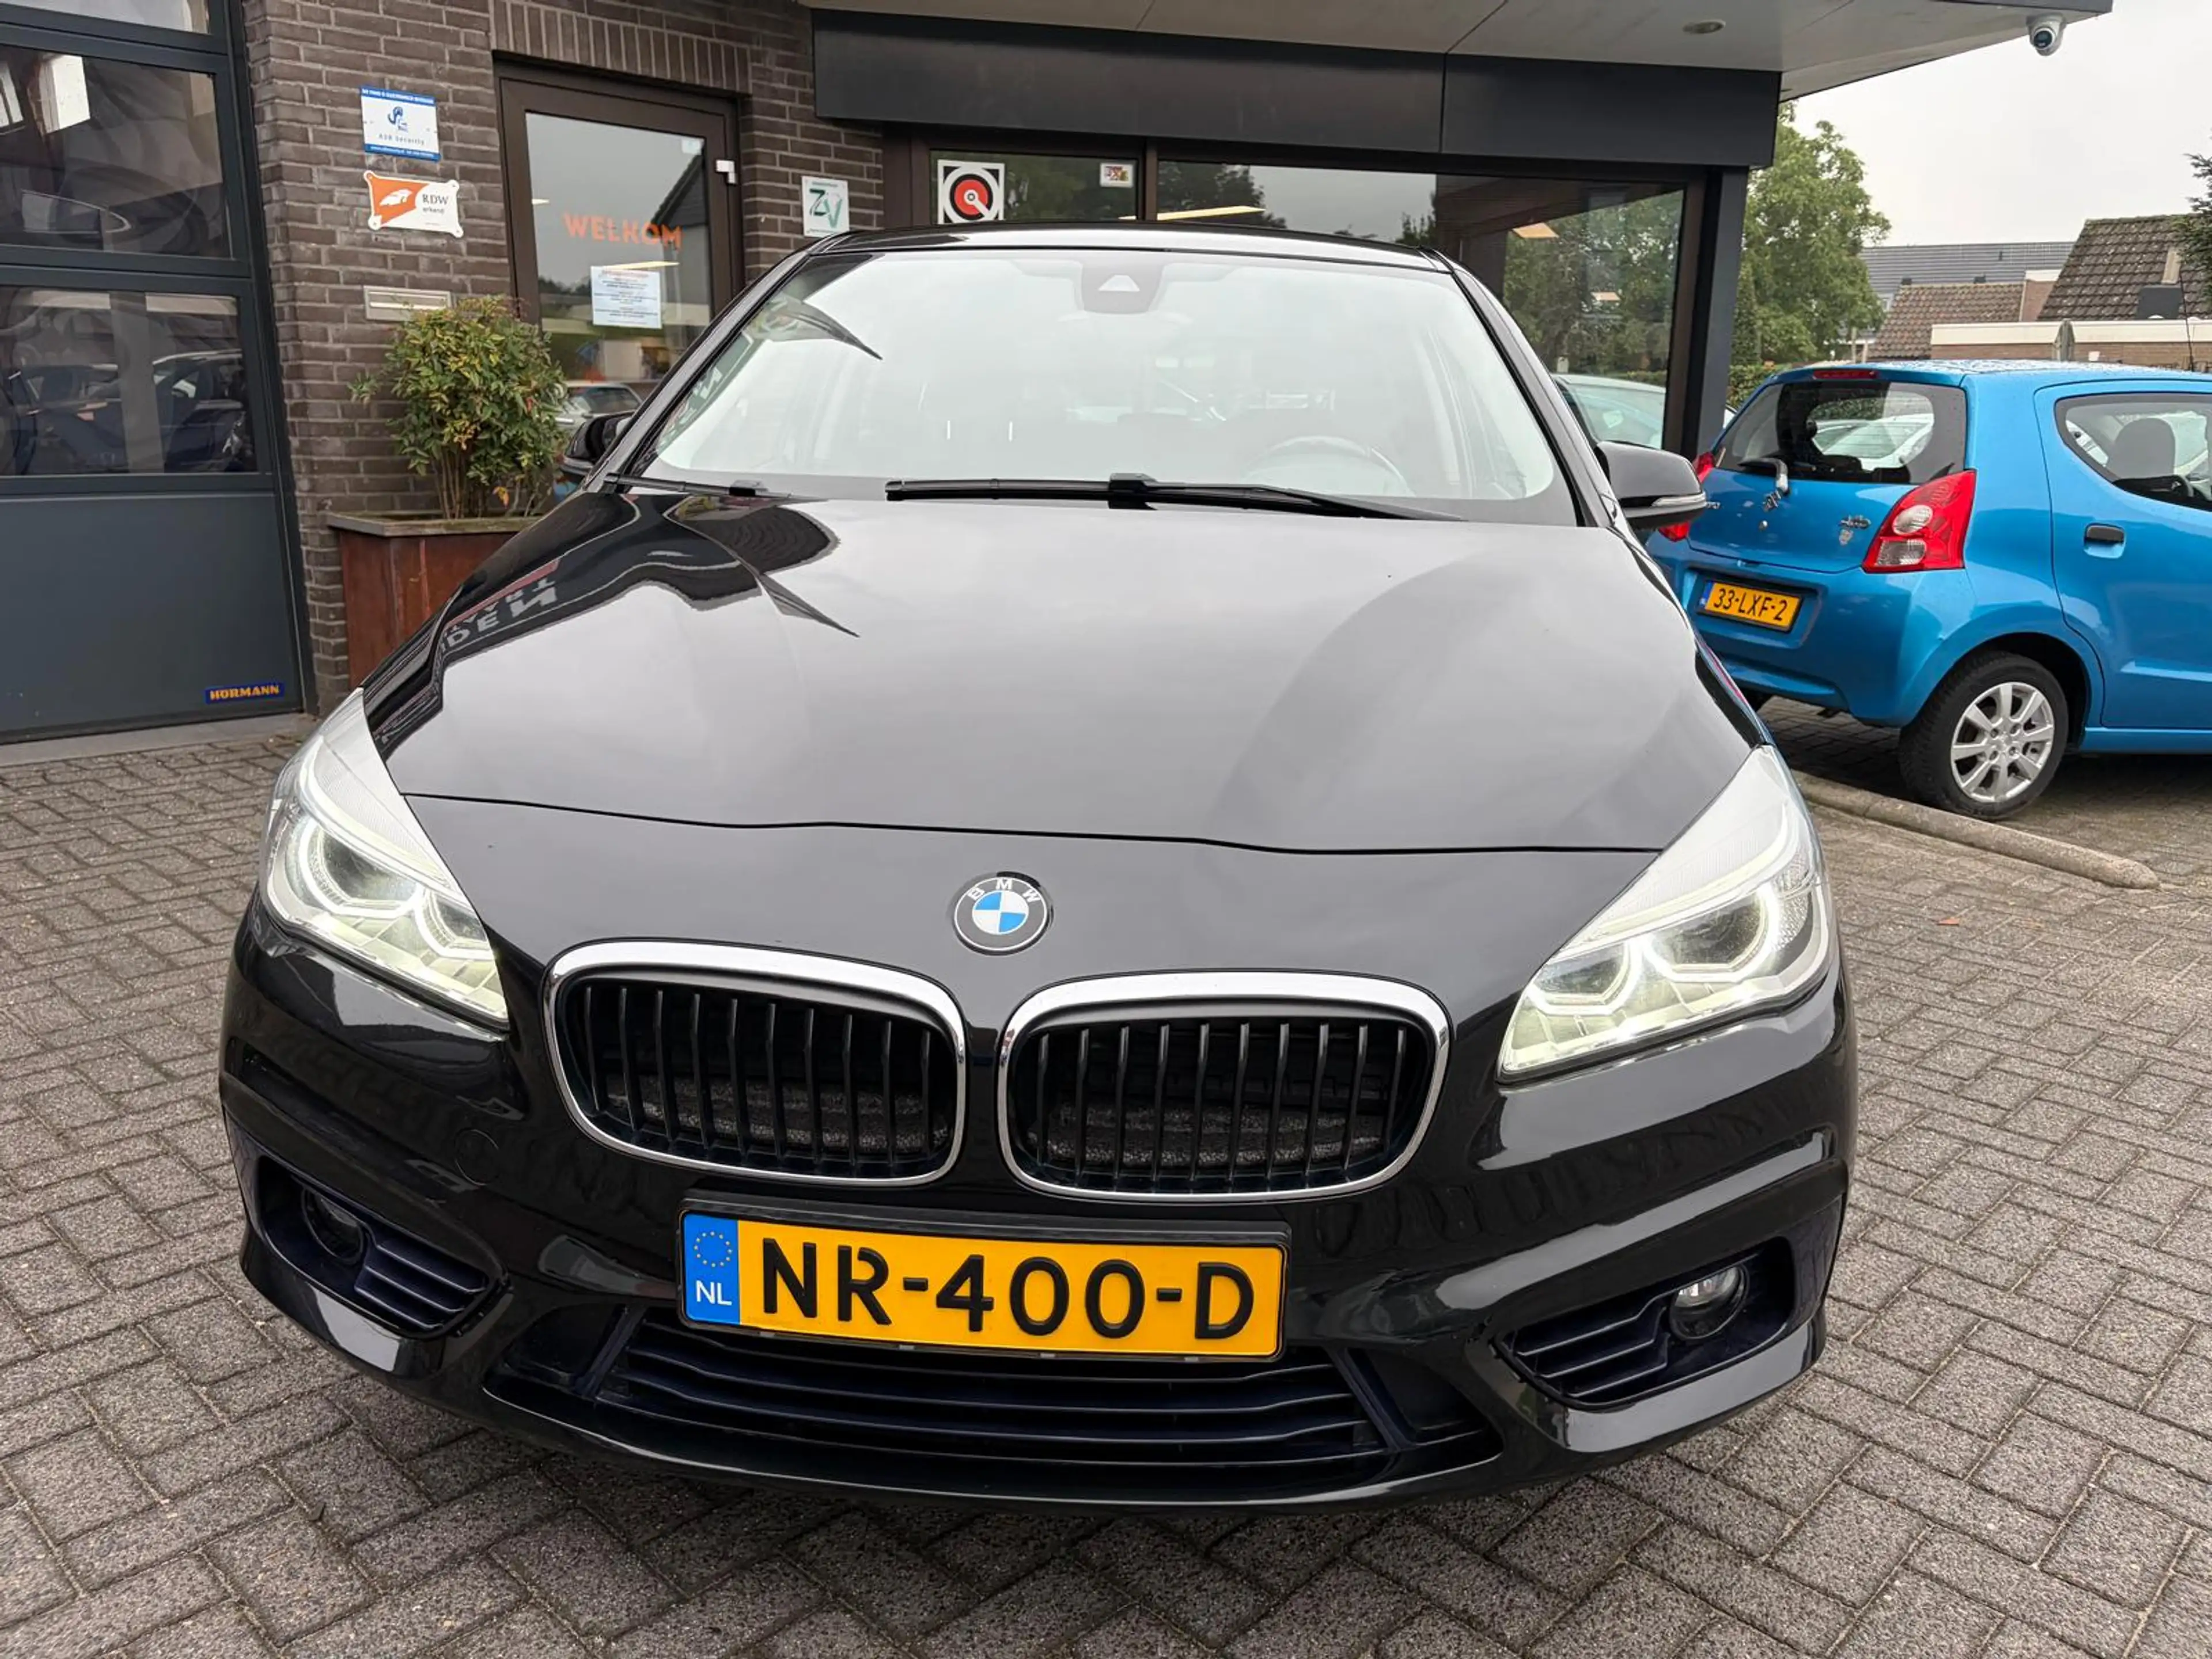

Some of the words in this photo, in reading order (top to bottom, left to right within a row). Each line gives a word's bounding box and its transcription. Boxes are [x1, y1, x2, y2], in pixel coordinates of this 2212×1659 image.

[422, 194, 449, 204] RDW
[563, 212, 683, 251] WELKOM
[1713, 588, 1788, 622] 33-LXF-2
[966, 878, 1041, 903] BMW
[695, 1280, 732, 1306] NL
[763, 1237, 1254, 1340] NR-400-D
